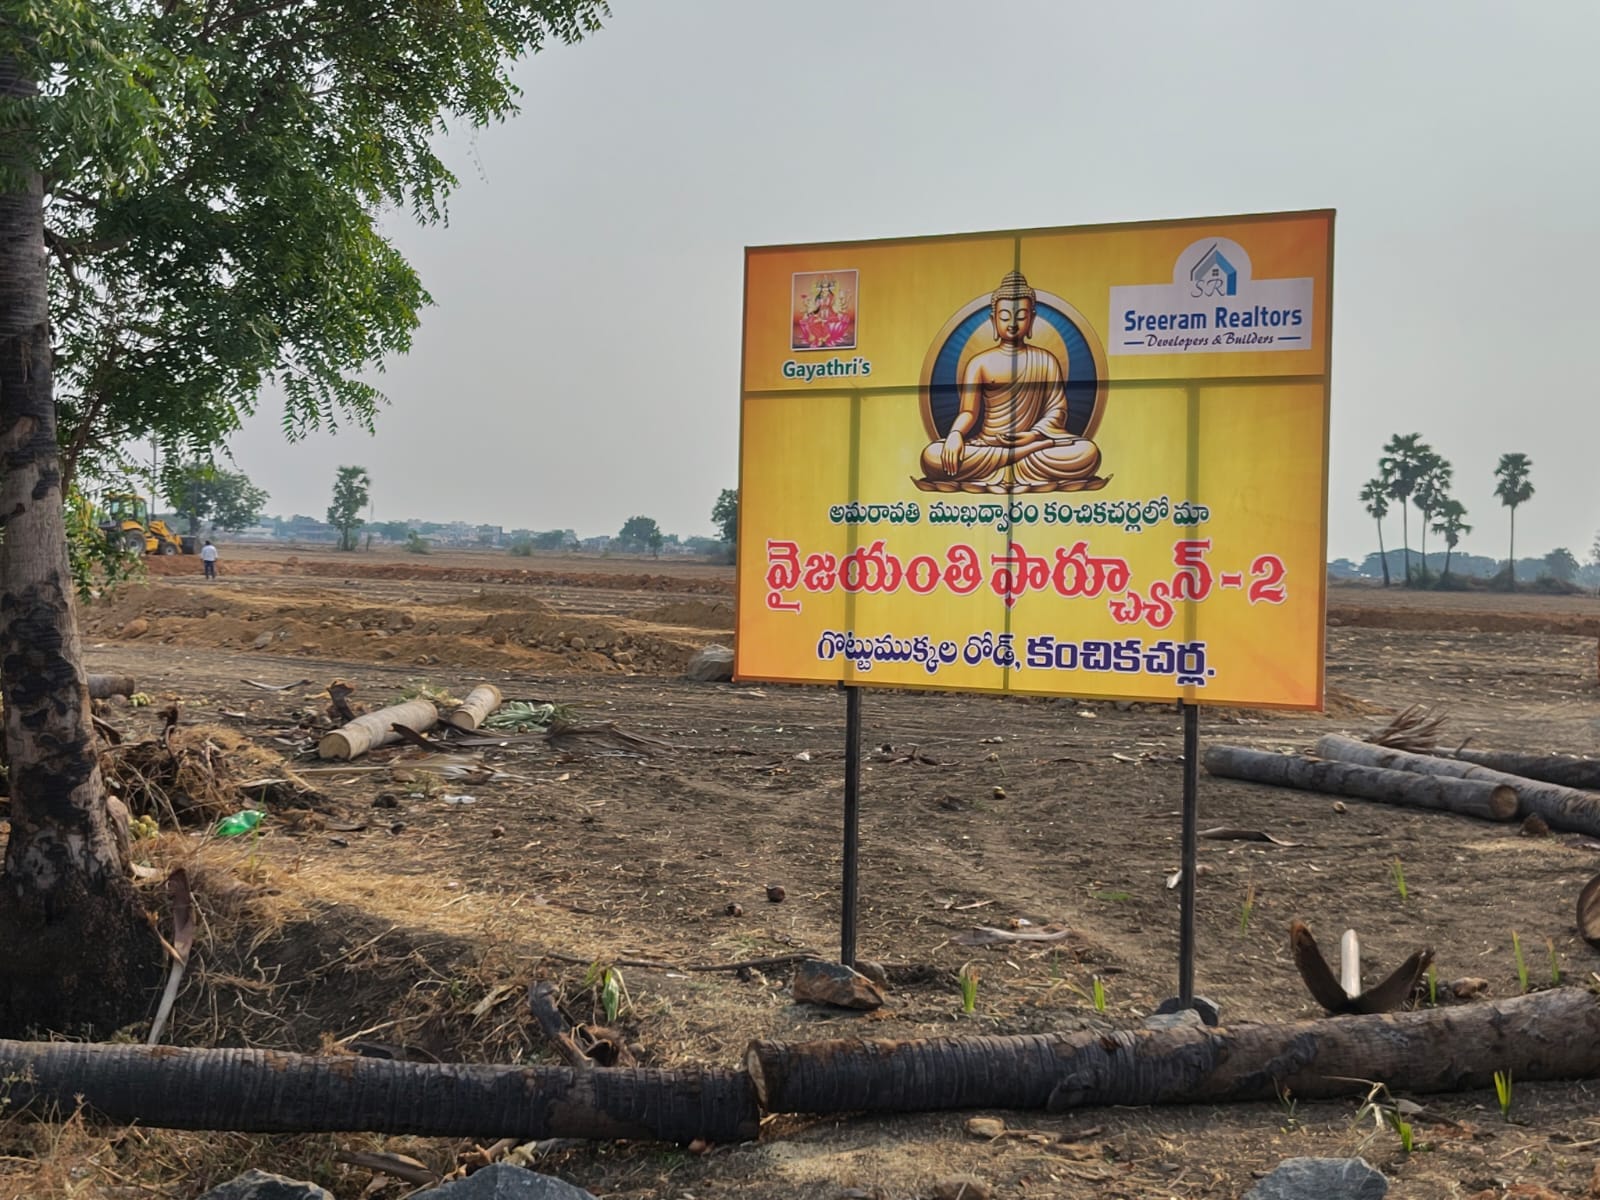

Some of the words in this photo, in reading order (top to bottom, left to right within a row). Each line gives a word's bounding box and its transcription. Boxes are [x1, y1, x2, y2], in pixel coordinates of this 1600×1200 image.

[1124, 310, 1207, 331] Sreeram
[1215, 305, 1302, 329] Realtors
[1145, 334, 1208, 350] Developers
[1211, 334, 1222, 345] &
[1223, 332, 1274, 345] Builders
[783, 358, 870, 381] Gayathri's
[830, 502, 920, 523] అమరావతి
[928, 501, 1039, 532] ముఖద్వారం
[1044, 496, 1169, 531] కంచికచర్లలో
[1173, 502, 1209, 525] మా
[767, 540, 982, 613] వైజయంతి
[818, 631, 957, 673] గొట్టుముక్కల
[963, 631, 1020, 670] రోడ్,
[1027, 637, 1214, 684] కంచికచర్ల.
